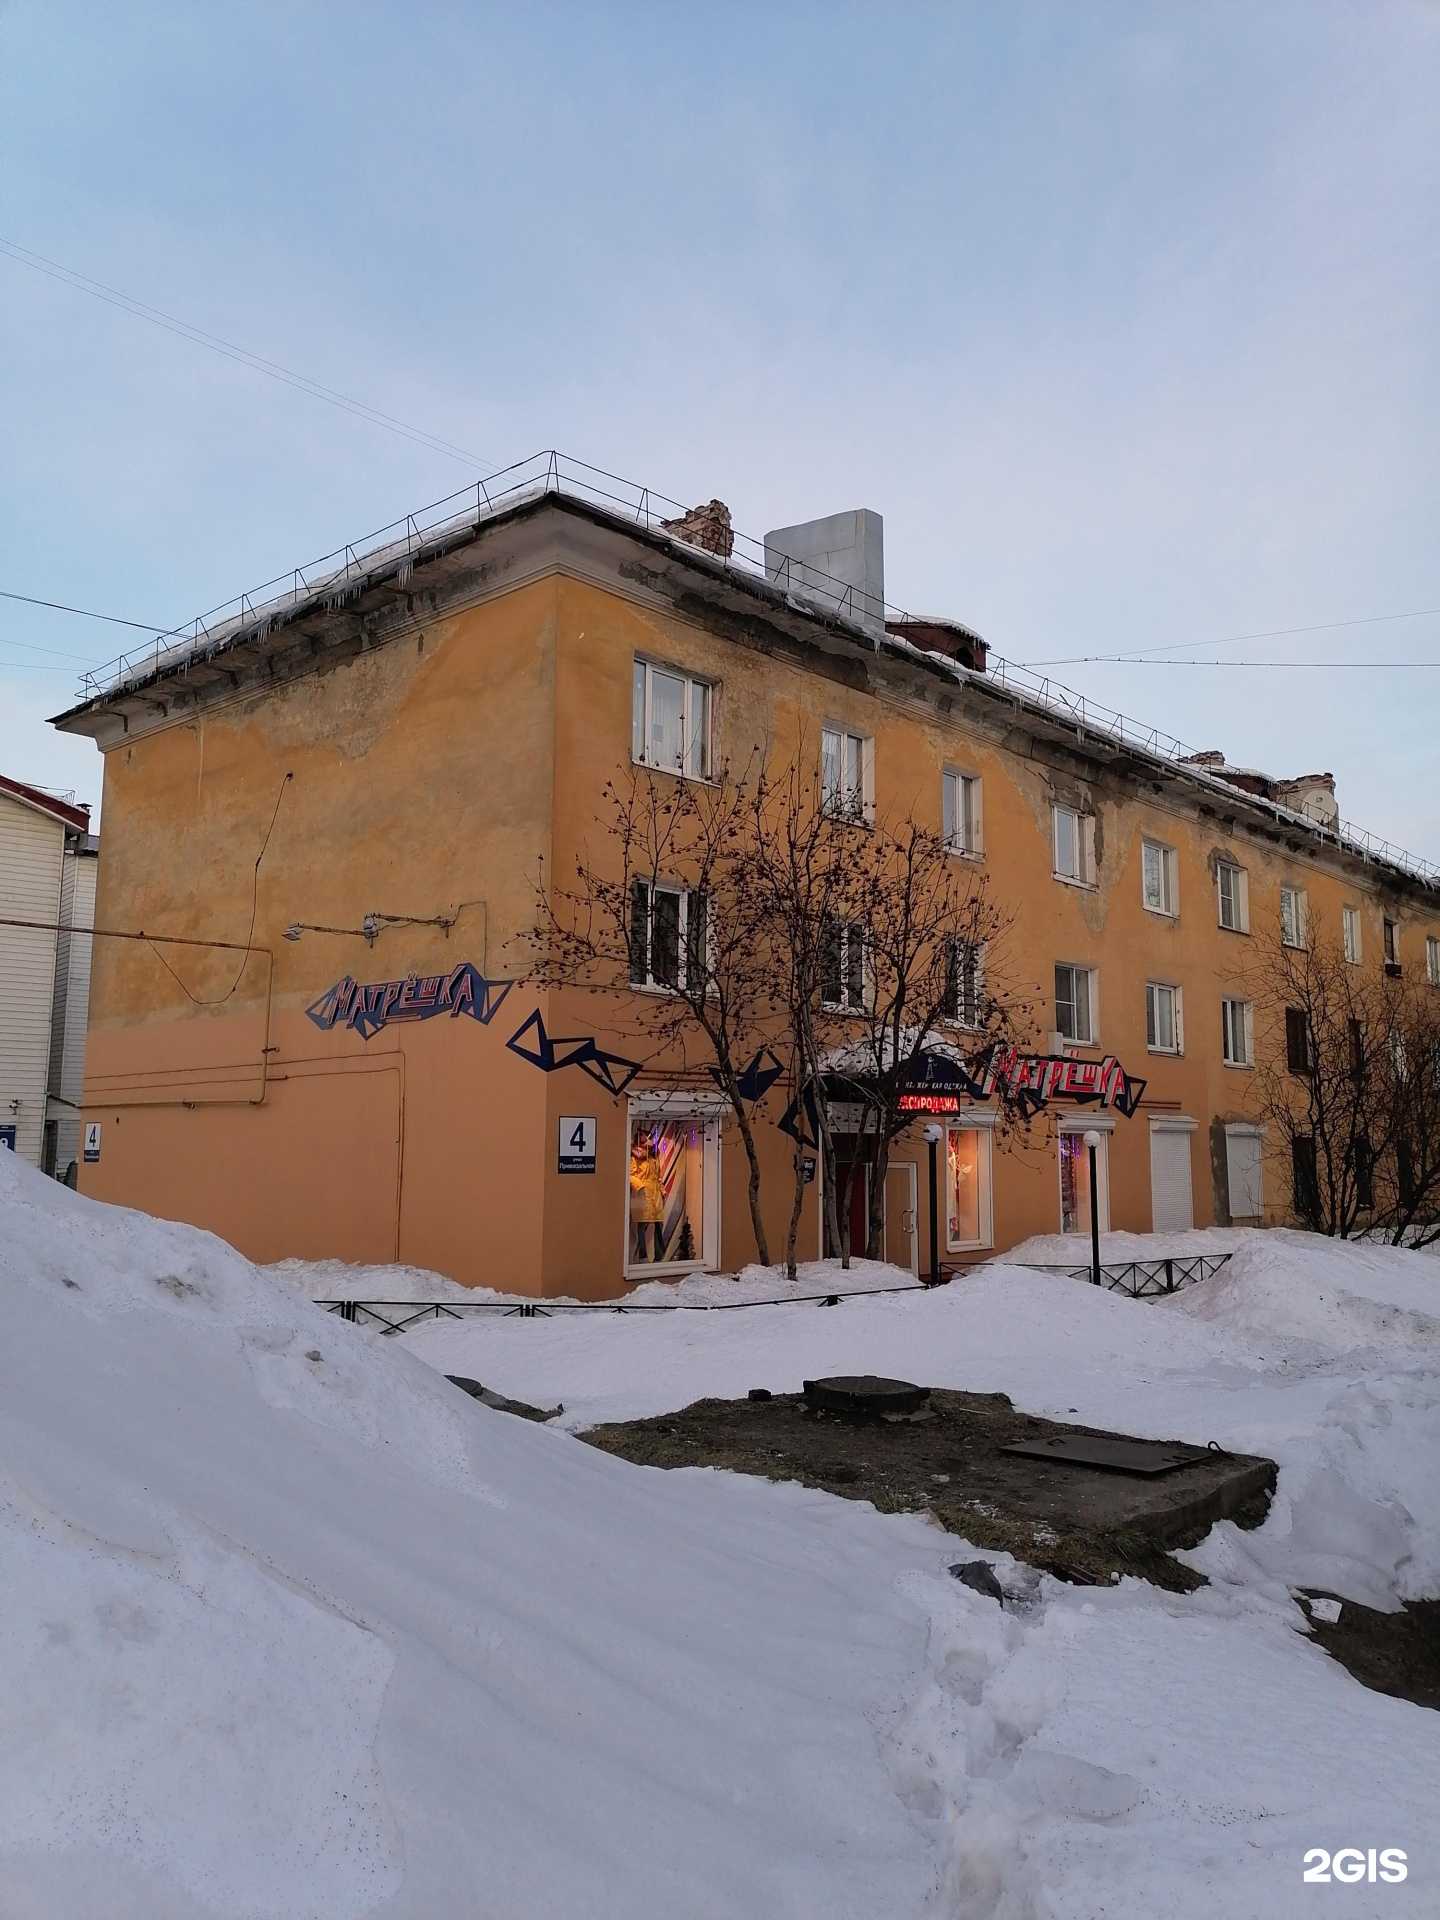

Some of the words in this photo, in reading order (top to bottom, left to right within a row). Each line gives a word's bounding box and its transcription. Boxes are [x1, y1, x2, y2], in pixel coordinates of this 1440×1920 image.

[327, 965, 473, 1028] МАТРЁШКА
[88, 1124, 97, 1147] 4
[569, 1121, 586, 1153] 4
